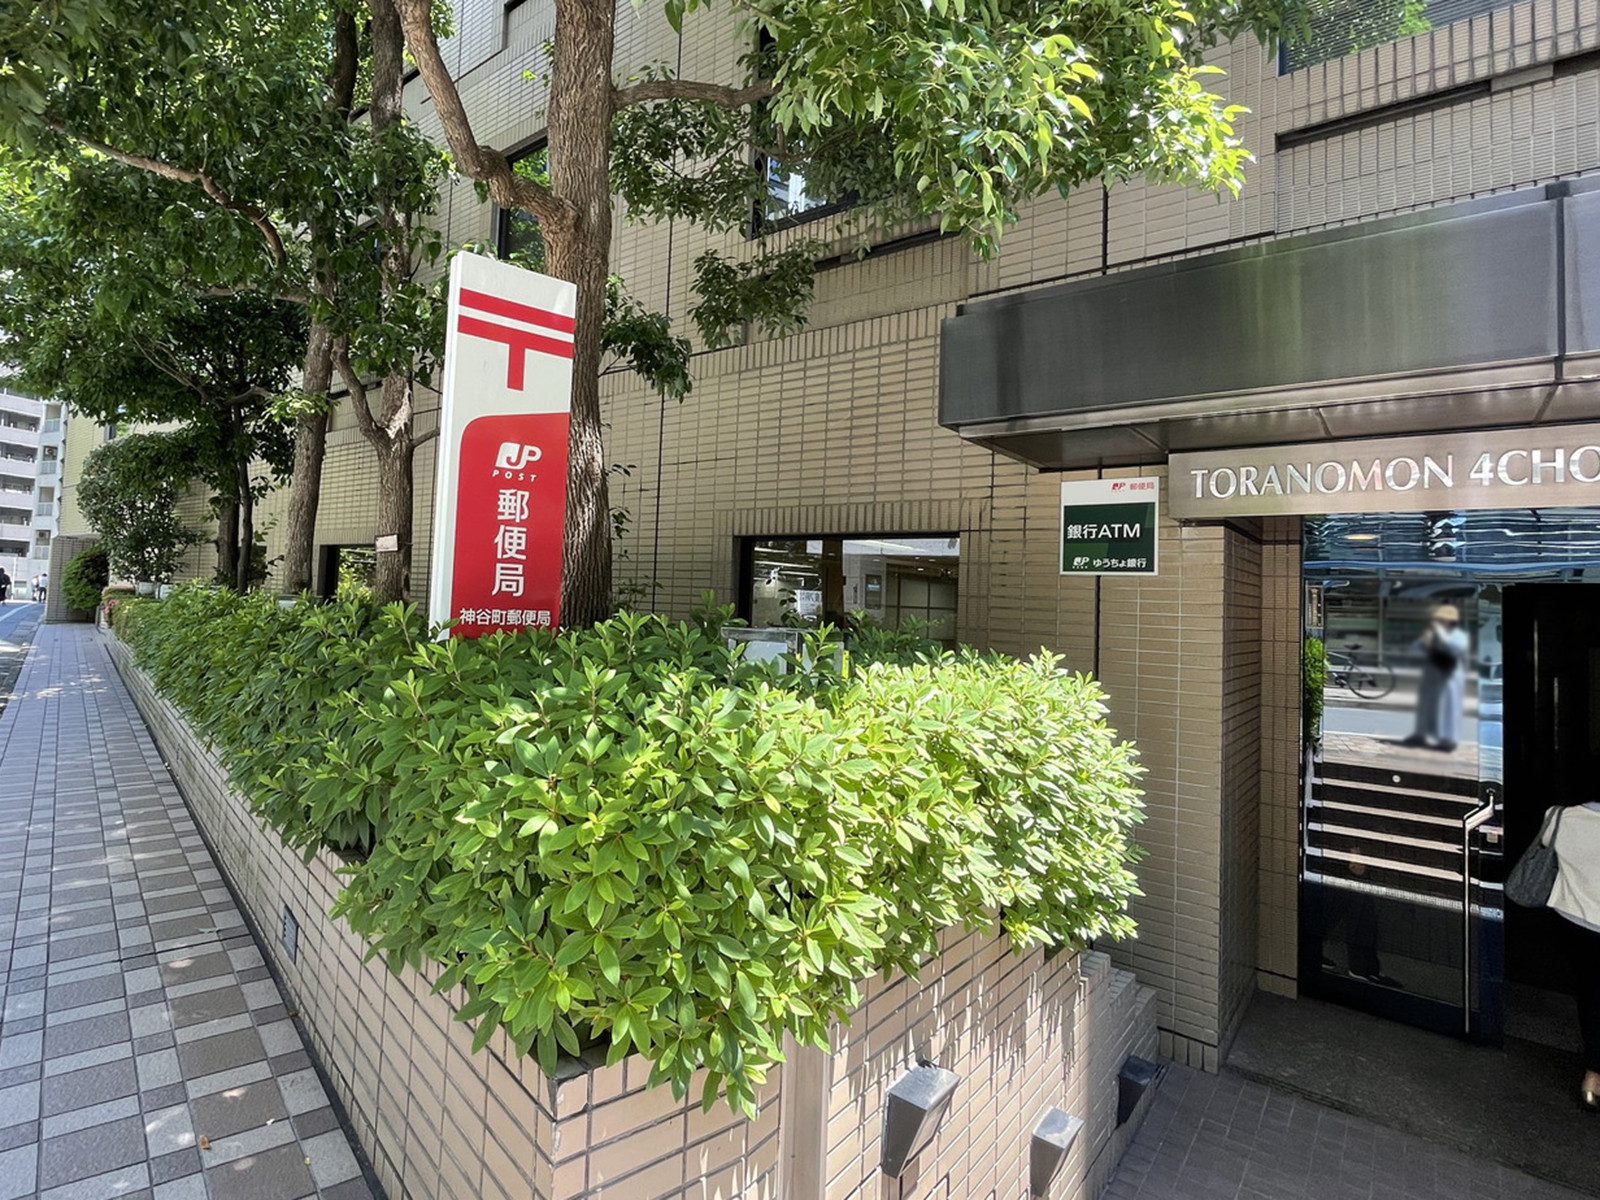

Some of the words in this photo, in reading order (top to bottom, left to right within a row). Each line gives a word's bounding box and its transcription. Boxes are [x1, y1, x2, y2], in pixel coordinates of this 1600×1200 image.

[492, 469, 537, 482] POST
[1190, 454, 1454, 499] TORANOMON
[1469, 444, 1600, 487] 4CHO
[1129, 481, 1155, 491] 郵便局
[1067, 523, 1141, 539] 銀行ATM
[491, 488, 530, 598] 郵便局
[1093, 557, 1147, 568] ゆうちょ銀行
[460, 608, 551, 627] 神谷町郵便局
